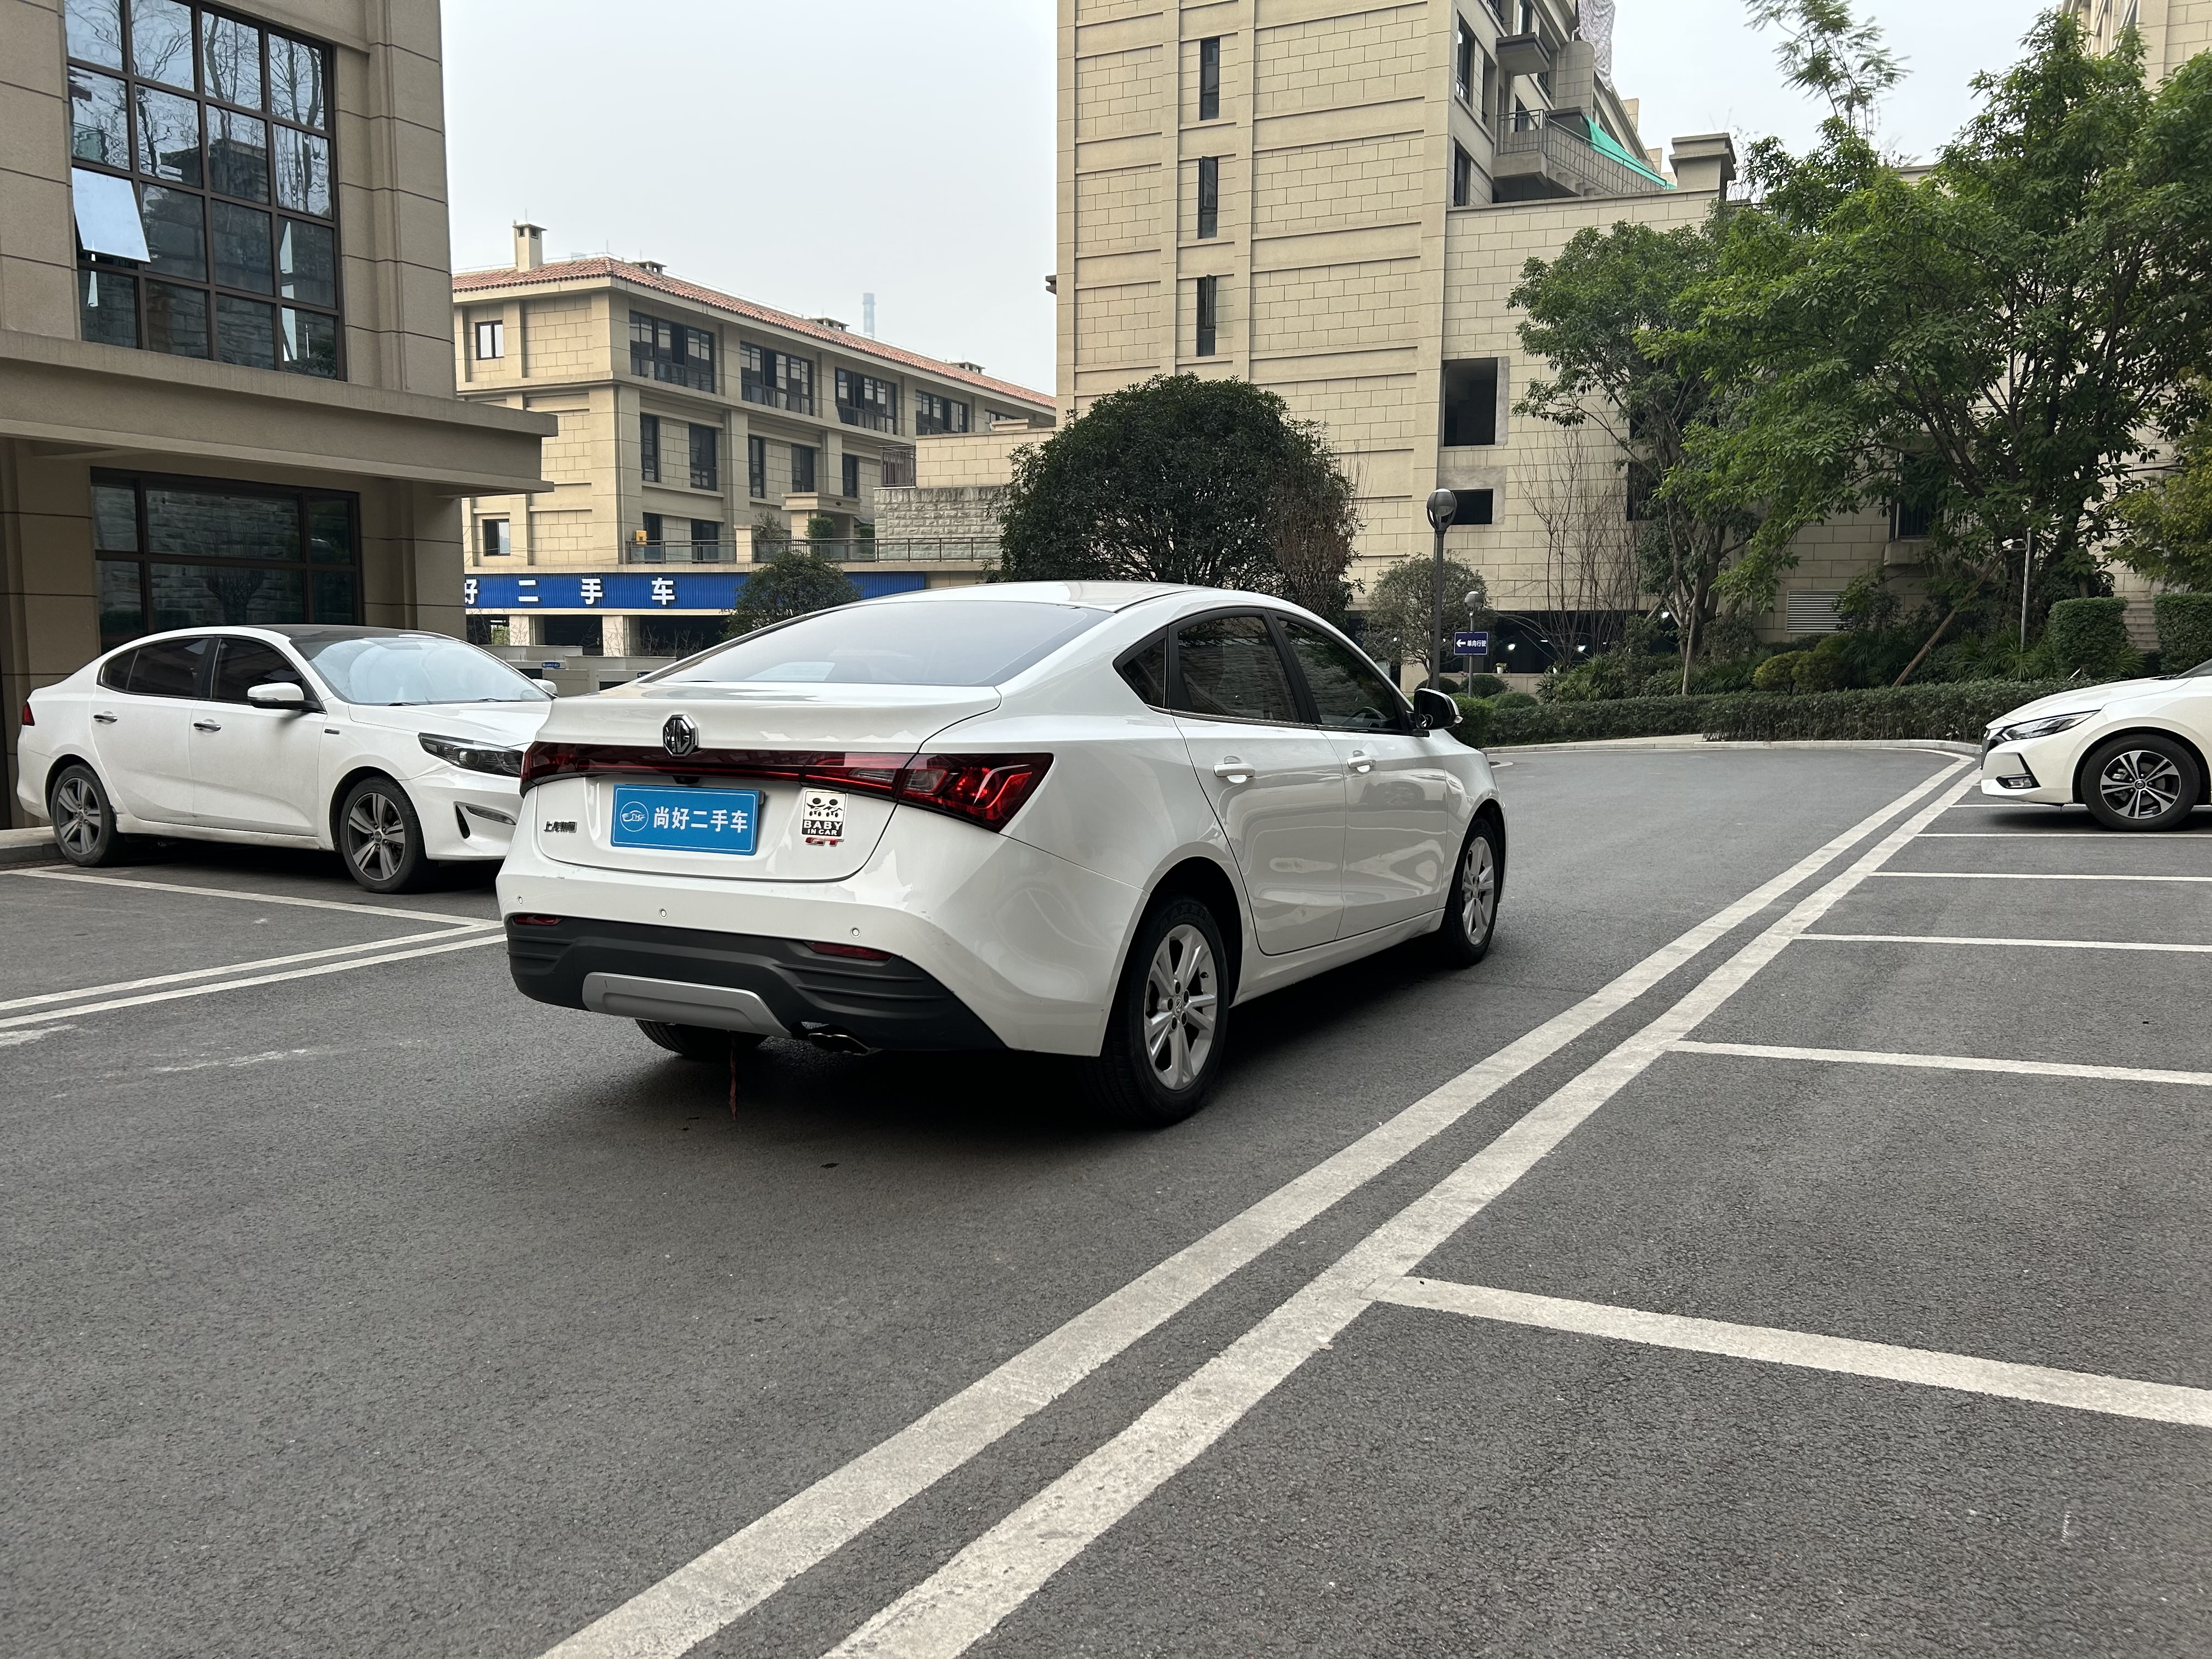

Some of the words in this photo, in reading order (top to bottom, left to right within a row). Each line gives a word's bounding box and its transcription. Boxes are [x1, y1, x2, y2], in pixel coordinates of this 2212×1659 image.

[653, 806, 748, 833] 尚好二手车
[804, 820, 842, 830] BABY
